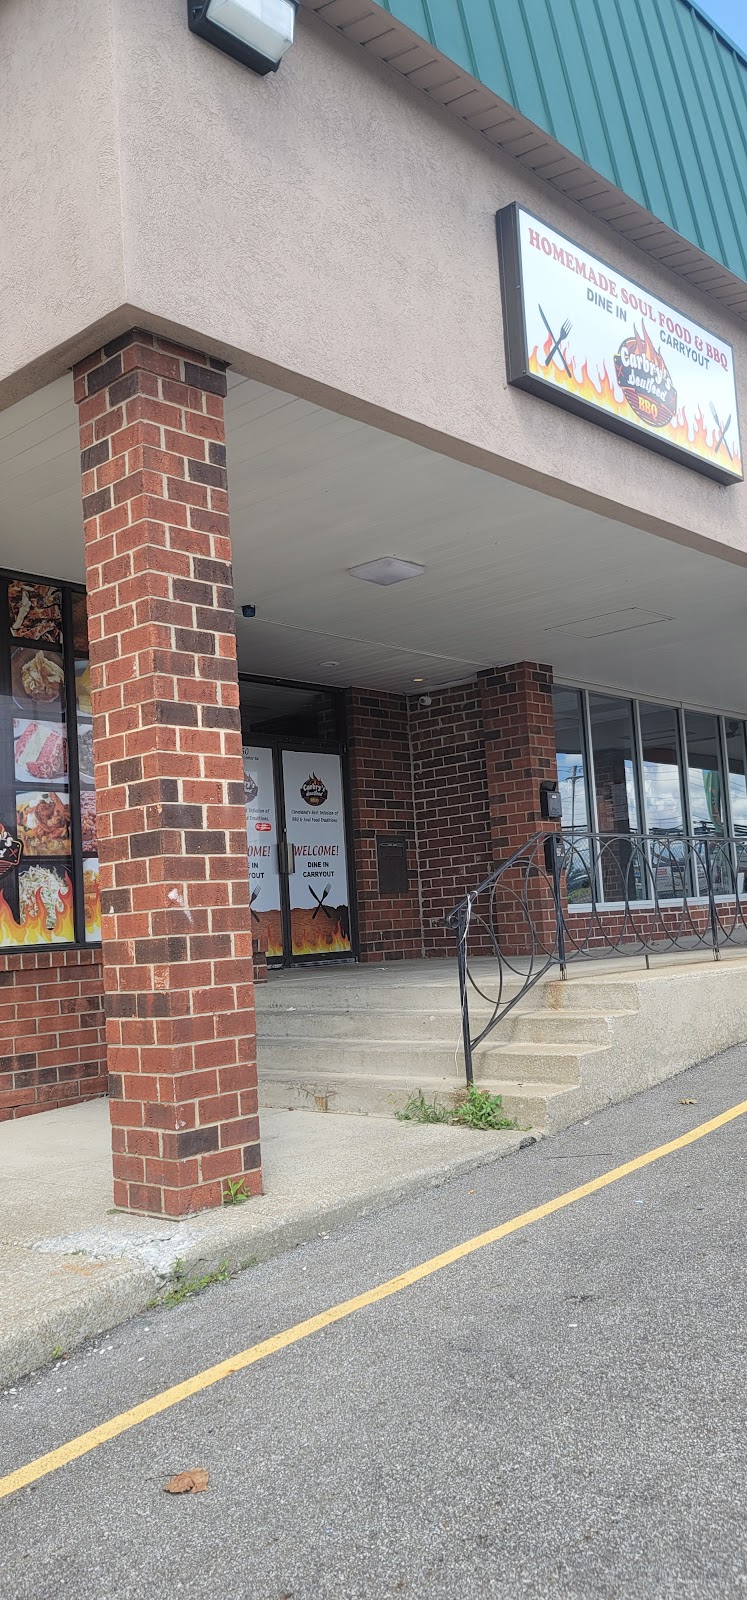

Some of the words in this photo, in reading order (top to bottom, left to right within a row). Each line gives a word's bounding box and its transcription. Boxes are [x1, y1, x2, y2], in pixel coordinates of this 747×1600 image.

[528, 227, 618, 299] HOMEMADE
[620, 287, 656, 323] SOUL
[657, 310, 692, 345] FOOD
[694, 335, 704, 352] &
[705, 342, 728, 372] BBQ
[586, 287, 613, 314] DINE
[615, 305, 627, 322] IN
[620, 346, 673, 391] Carbry's
[659, 329, 710, 370] CARRYOUT
[637, 395, 658, 419] BBQ
[294, 845, 339, 856] WELCOME!
